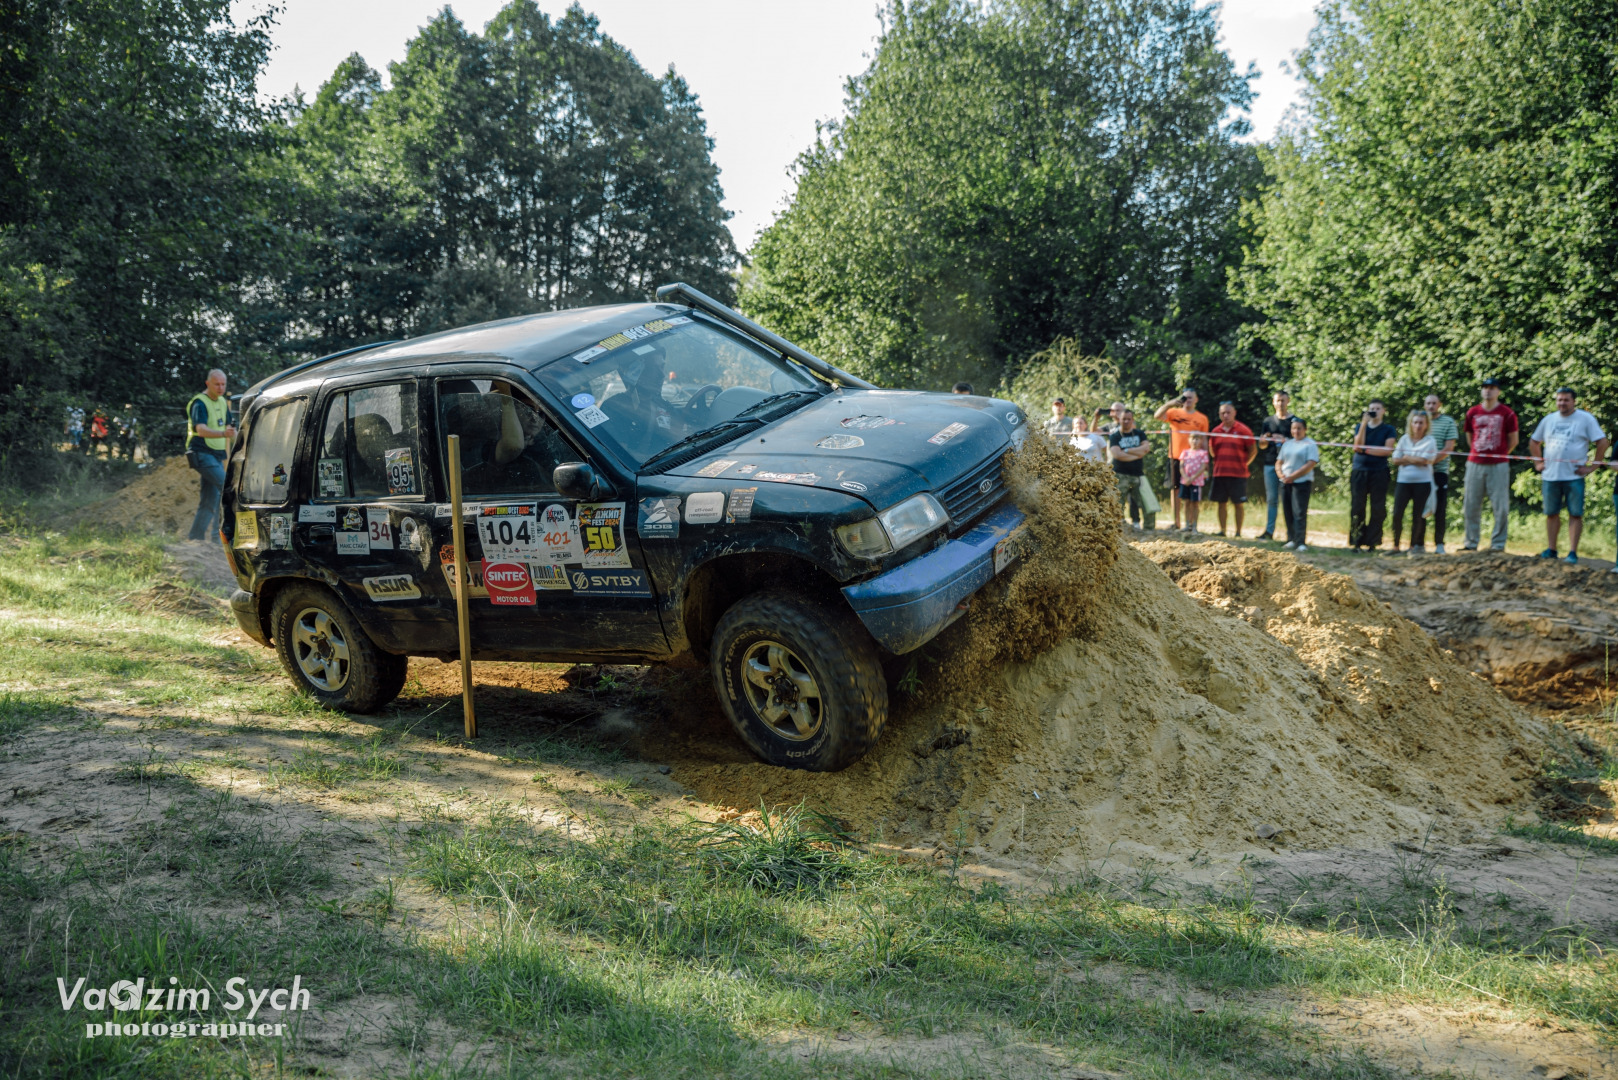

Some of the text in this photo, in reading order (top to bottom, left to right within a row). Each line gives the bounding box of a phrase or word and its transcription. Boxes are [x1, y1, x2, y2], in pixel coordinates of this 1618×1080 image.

[577, 395, 591, 406] 12
[392, 464, 410, 487] 95
[594, 509, 619, 519] ДЖИП
[370, 521, 391, 541] 34
[486, 520, 532, 546] 104
[543, 531, 571, 546] 401
[586, 526, 616, 550] 50
[352, 541, 367, 549] СТАЙЛ
[487, 571, 526, 582] SINTEC
[590, 576, 641, 587] SVT.BY
[496, 595, 532, 603] MOTOR OIL
